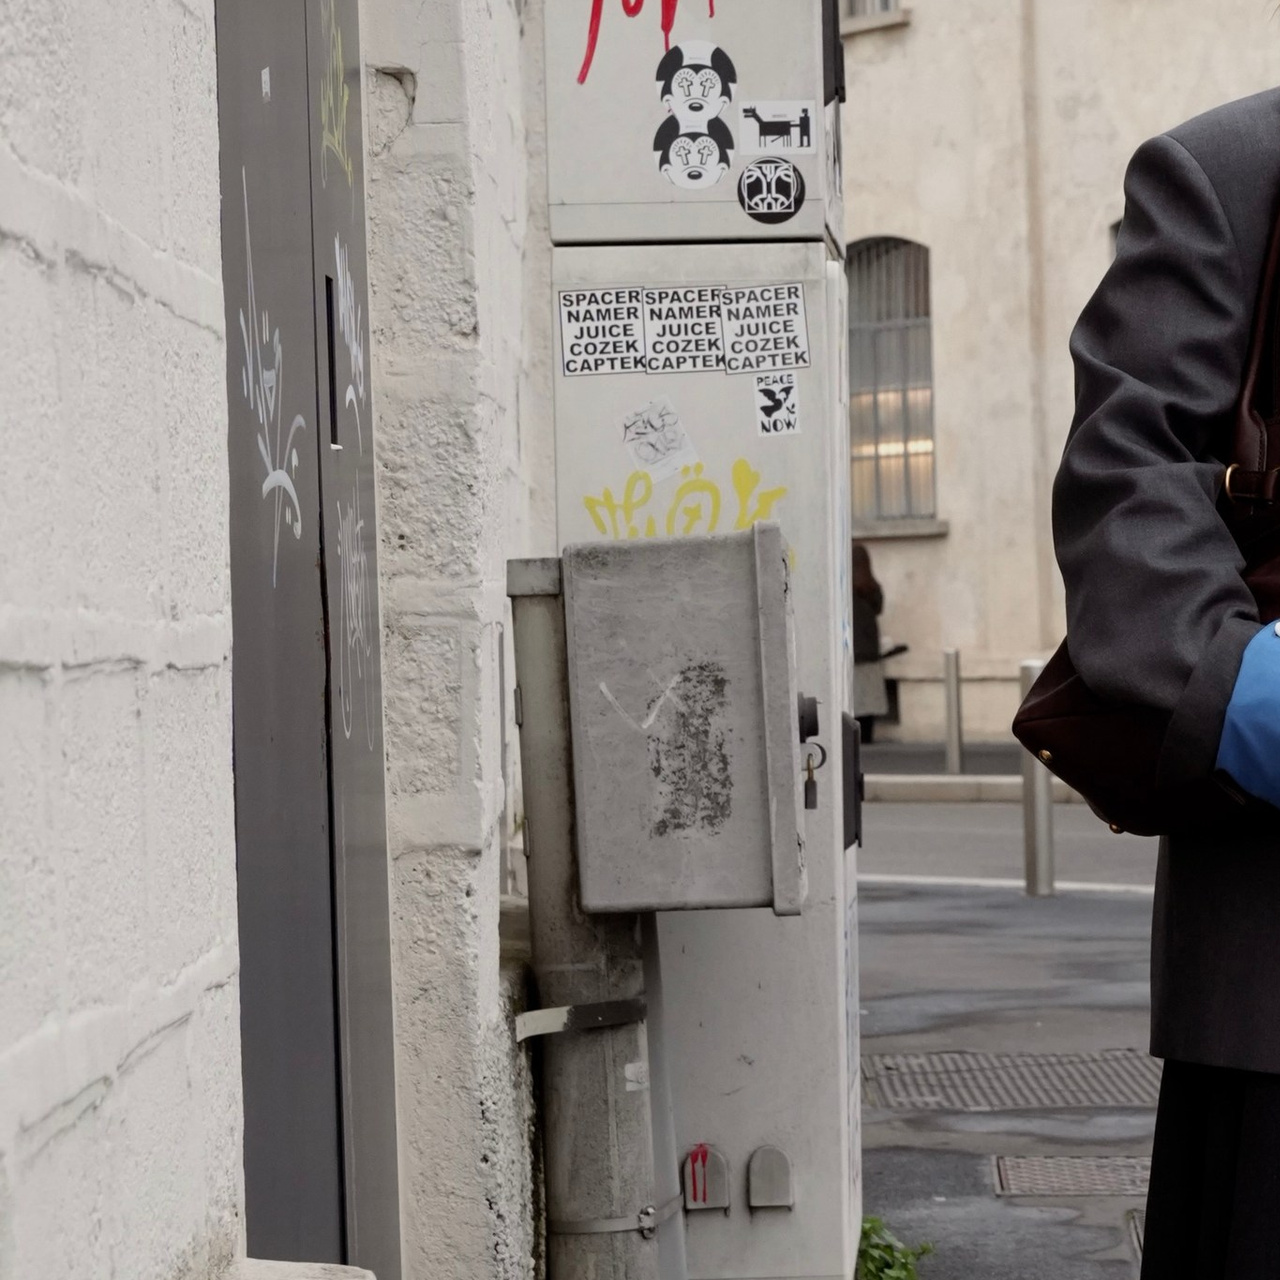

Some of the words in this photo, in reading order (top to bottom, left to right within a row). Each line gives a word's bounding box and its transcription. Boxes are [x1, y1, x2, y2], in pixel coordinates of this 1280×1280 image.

[562, 290, 641, 307] SPACER
[645, 288, 720, 305] SPACER
[722, 286, 800, 306] SPACER
[567, 306, 639, 323] NAMER
[650, 305, 721, 321] NAMER
[727, 302, 799, 321] NAMER
[574, 324, 634, 340] JUICE
[656, 322, 716, 338] JUICE
[734, 320, 795, 338] JUICE
[570, 340, 639, 356] COZEK
[652, 338, 721, 354] COZEK
[731, 335, 800, 354] COZEK
[566, 356, 646, 373] CAPTEK
[648, 354, 726, 370] CAPTEK
[728, 351, 808, 370] CAPTEK
[756, 374, 794, 387] PEACE
[760, 418, 797, 433] NOW
